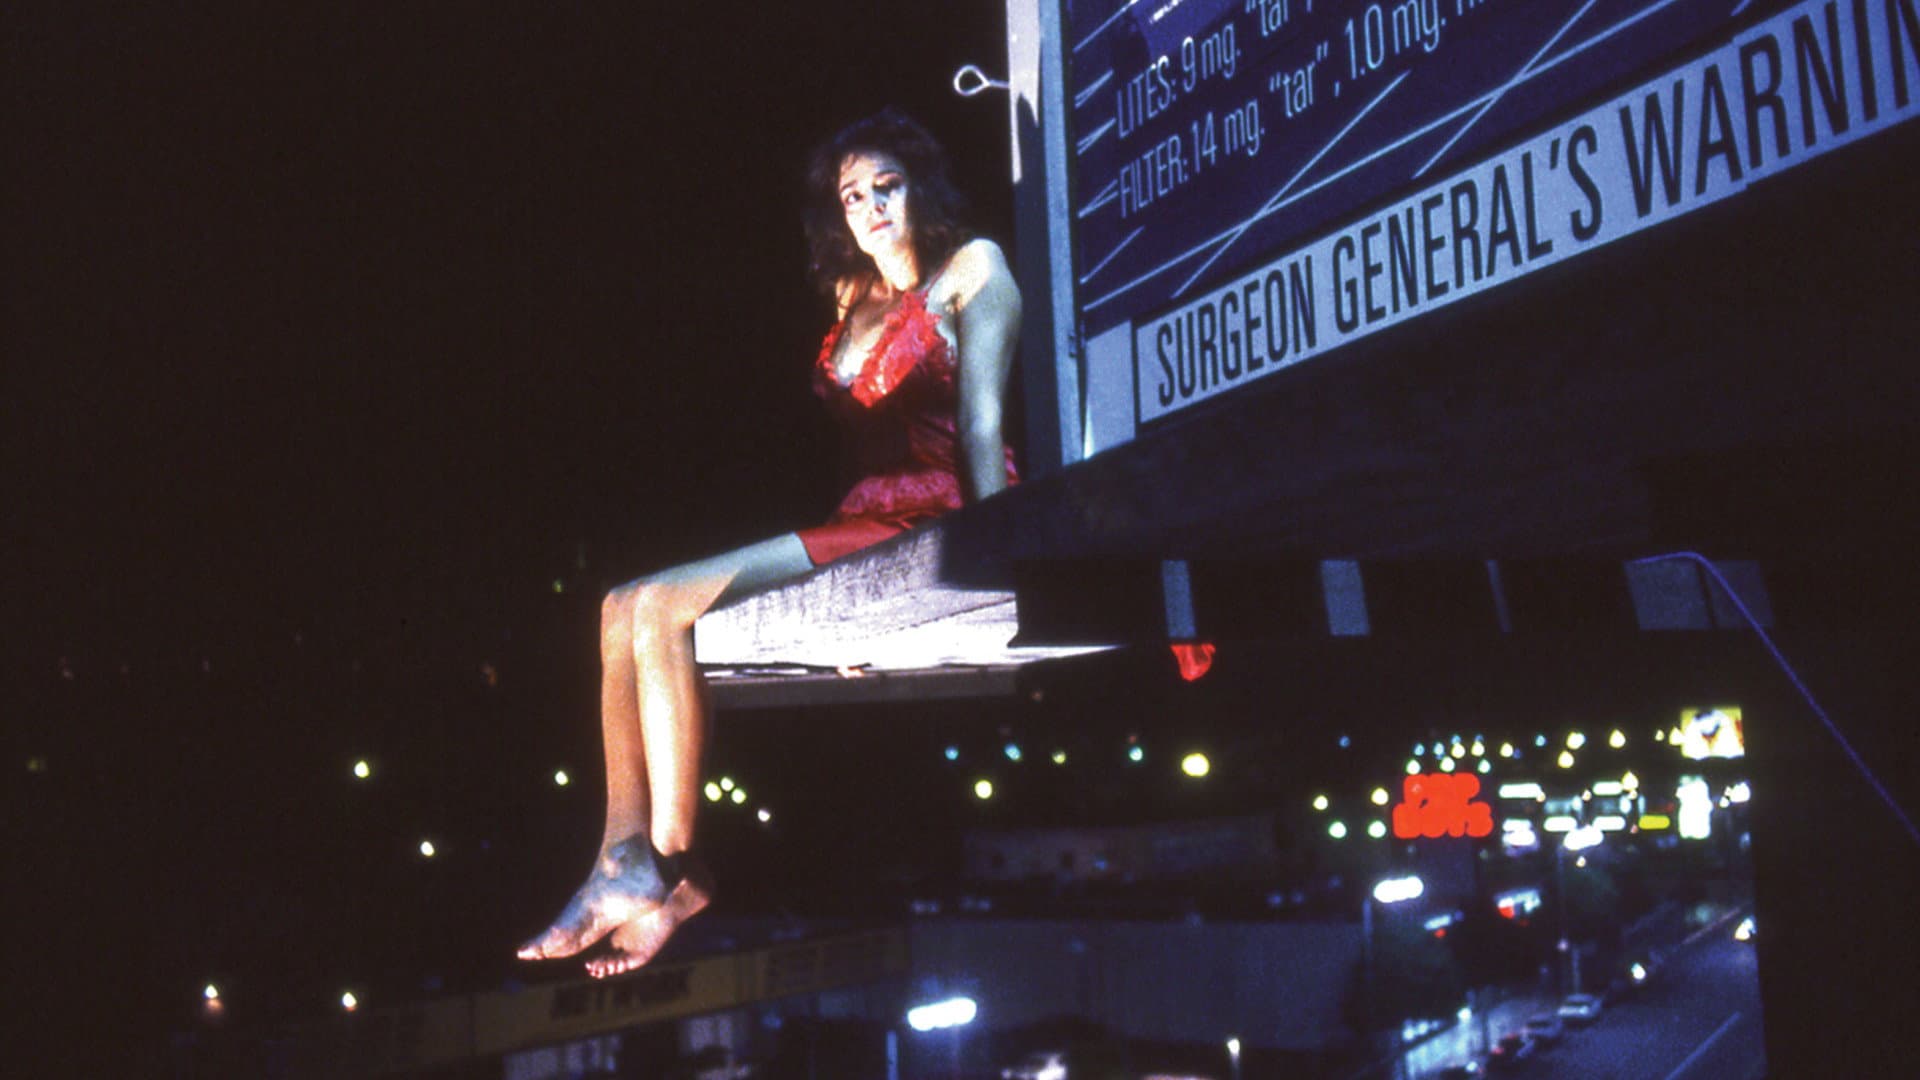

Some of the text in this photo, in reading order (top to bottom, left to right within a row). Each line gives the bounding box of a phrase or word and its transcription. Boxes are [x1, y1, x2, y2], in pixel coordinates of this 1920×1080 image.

[1116, 56, 1176, 139] LITES:
[1181, 36, 1197, 93] 9
[1202, 22, 1241, 80] mg.
[1119, 134, 1189, 219] FILTER:
[1192, 112, 1218, 173] 14
[1224, 99, 1266, 157] mg.
[1344, 4, 1386, 80] 1.0
[1391, 0, 1446, 53] mg.
[1156, 255, 1317, 407] SURGEON
[1332, 124, 1602, 335] GENERAL'S
